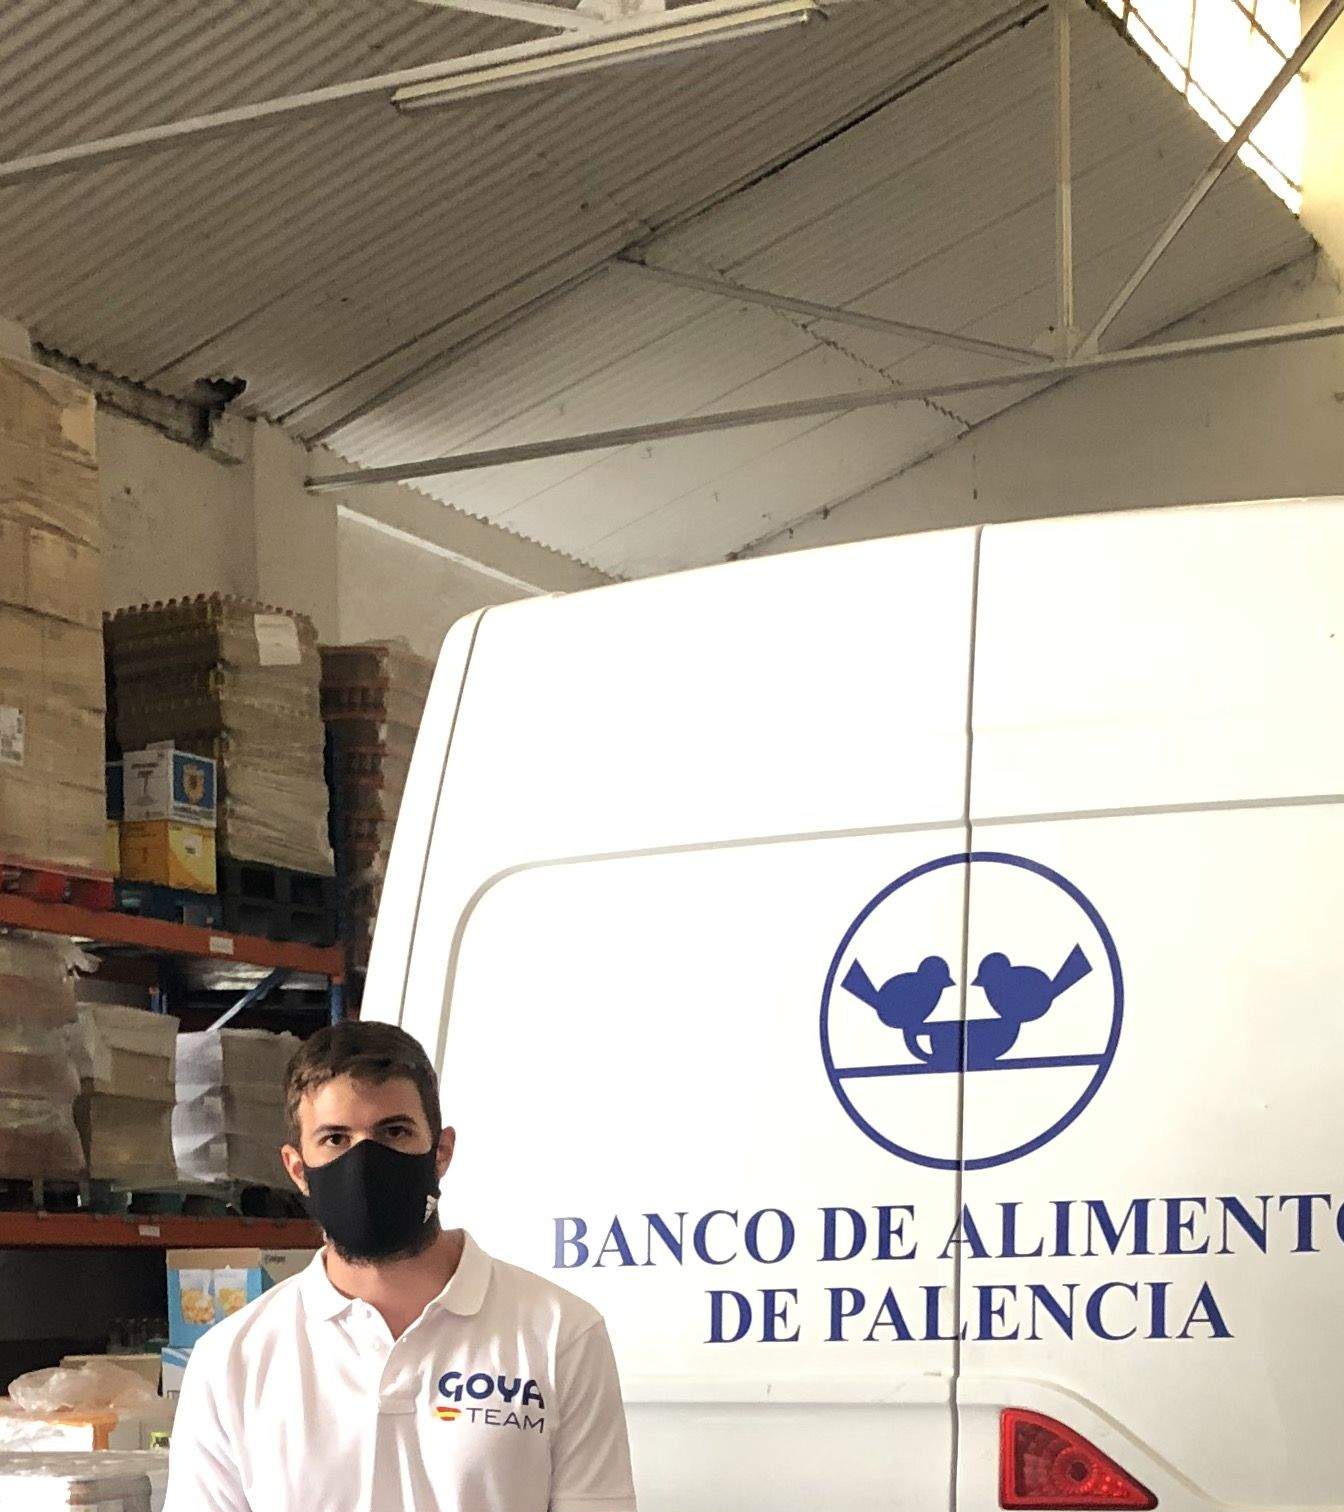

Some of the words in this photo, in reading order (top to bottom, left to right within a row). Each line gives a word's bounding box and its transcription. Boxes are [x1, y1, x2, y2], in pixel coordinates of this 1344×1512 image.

[551, 1206, 796, 1269] BANCO
[816, 1204, 918, 1262] DE
[702, 1287, 801, 1344] DE
[823, 1281, 1235, 1343] PALENCIA
[438, 1371, 545, 1410] GOYA
[466, 1407, 545, 1434] TEAM
